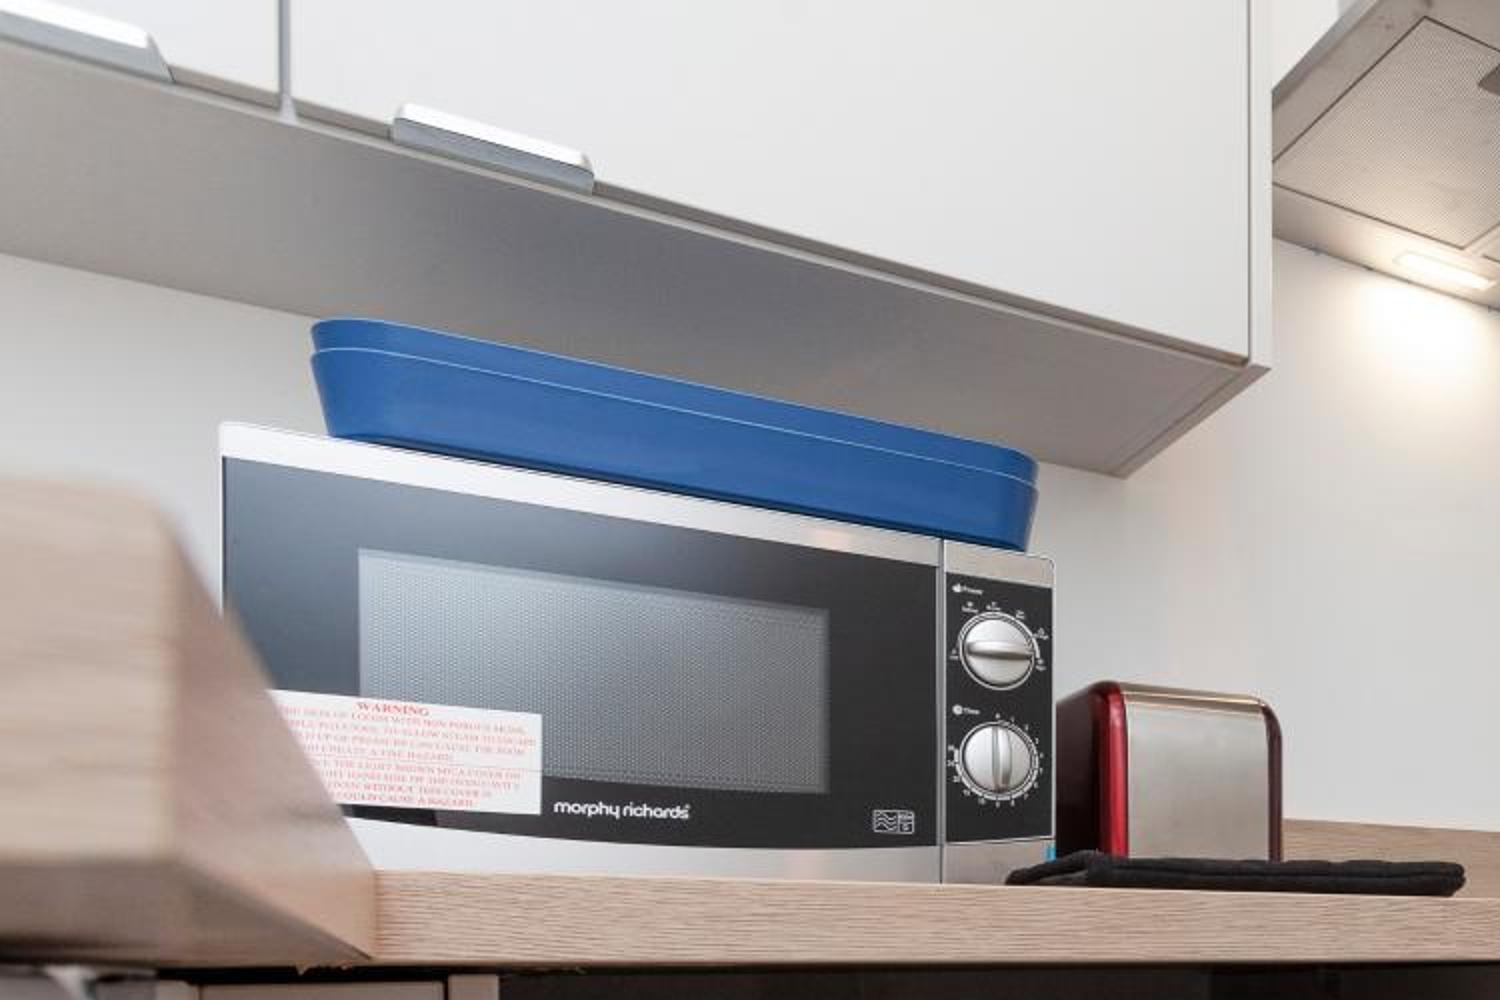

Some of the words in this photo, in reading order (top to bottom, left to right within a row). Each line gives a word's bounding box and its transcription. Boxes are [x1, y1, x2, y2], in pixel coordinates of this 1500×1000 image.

[356, 701, 430, 717] WARNING
[553, 801, 620, 820] morphy
[622, 802, 690, 820] richards
